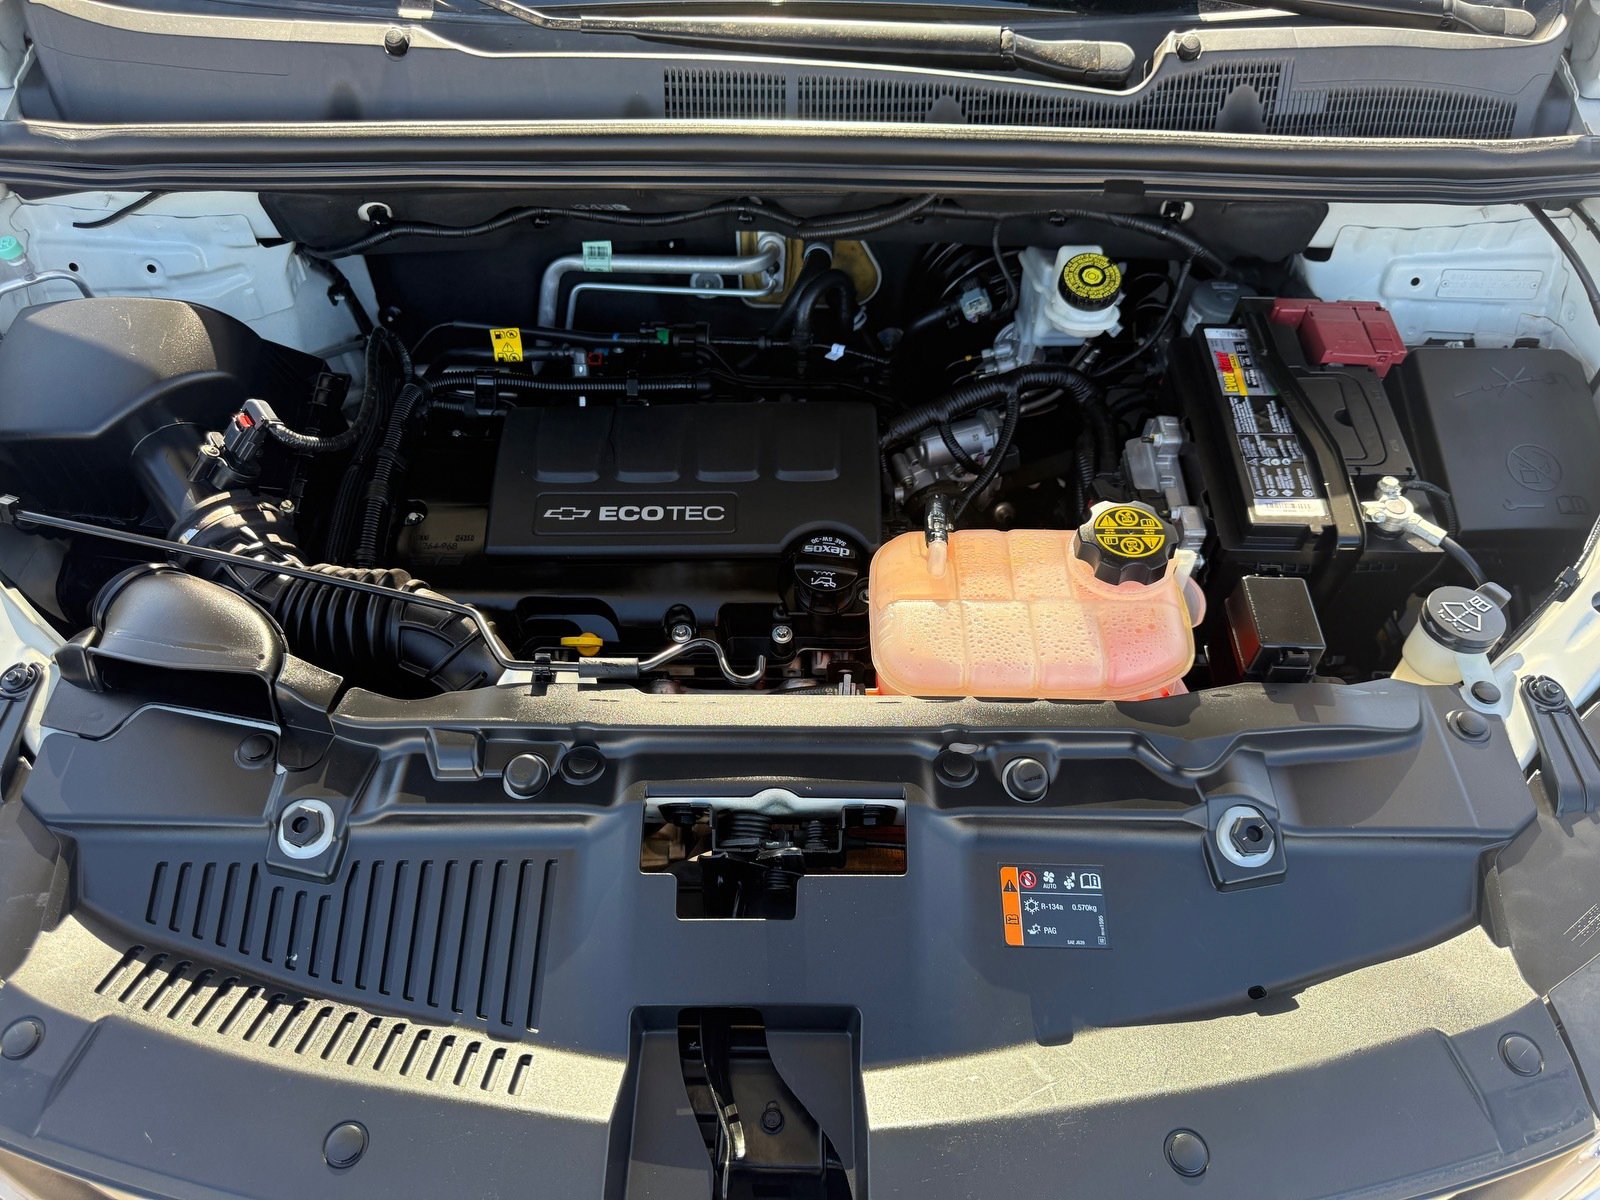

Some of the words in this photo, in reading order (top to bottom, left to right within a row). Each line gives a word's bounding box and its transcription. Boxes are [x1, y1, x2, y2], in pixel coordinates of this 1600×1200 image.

[598, 505, 725, 521] ECOTEC
[811, 536, 832, 544] 5W-30
[835, 538, 846, 546] SAE
[804, 544, 849, 556] dexos
[1072, 904, 1097, 912] 0.570kg
